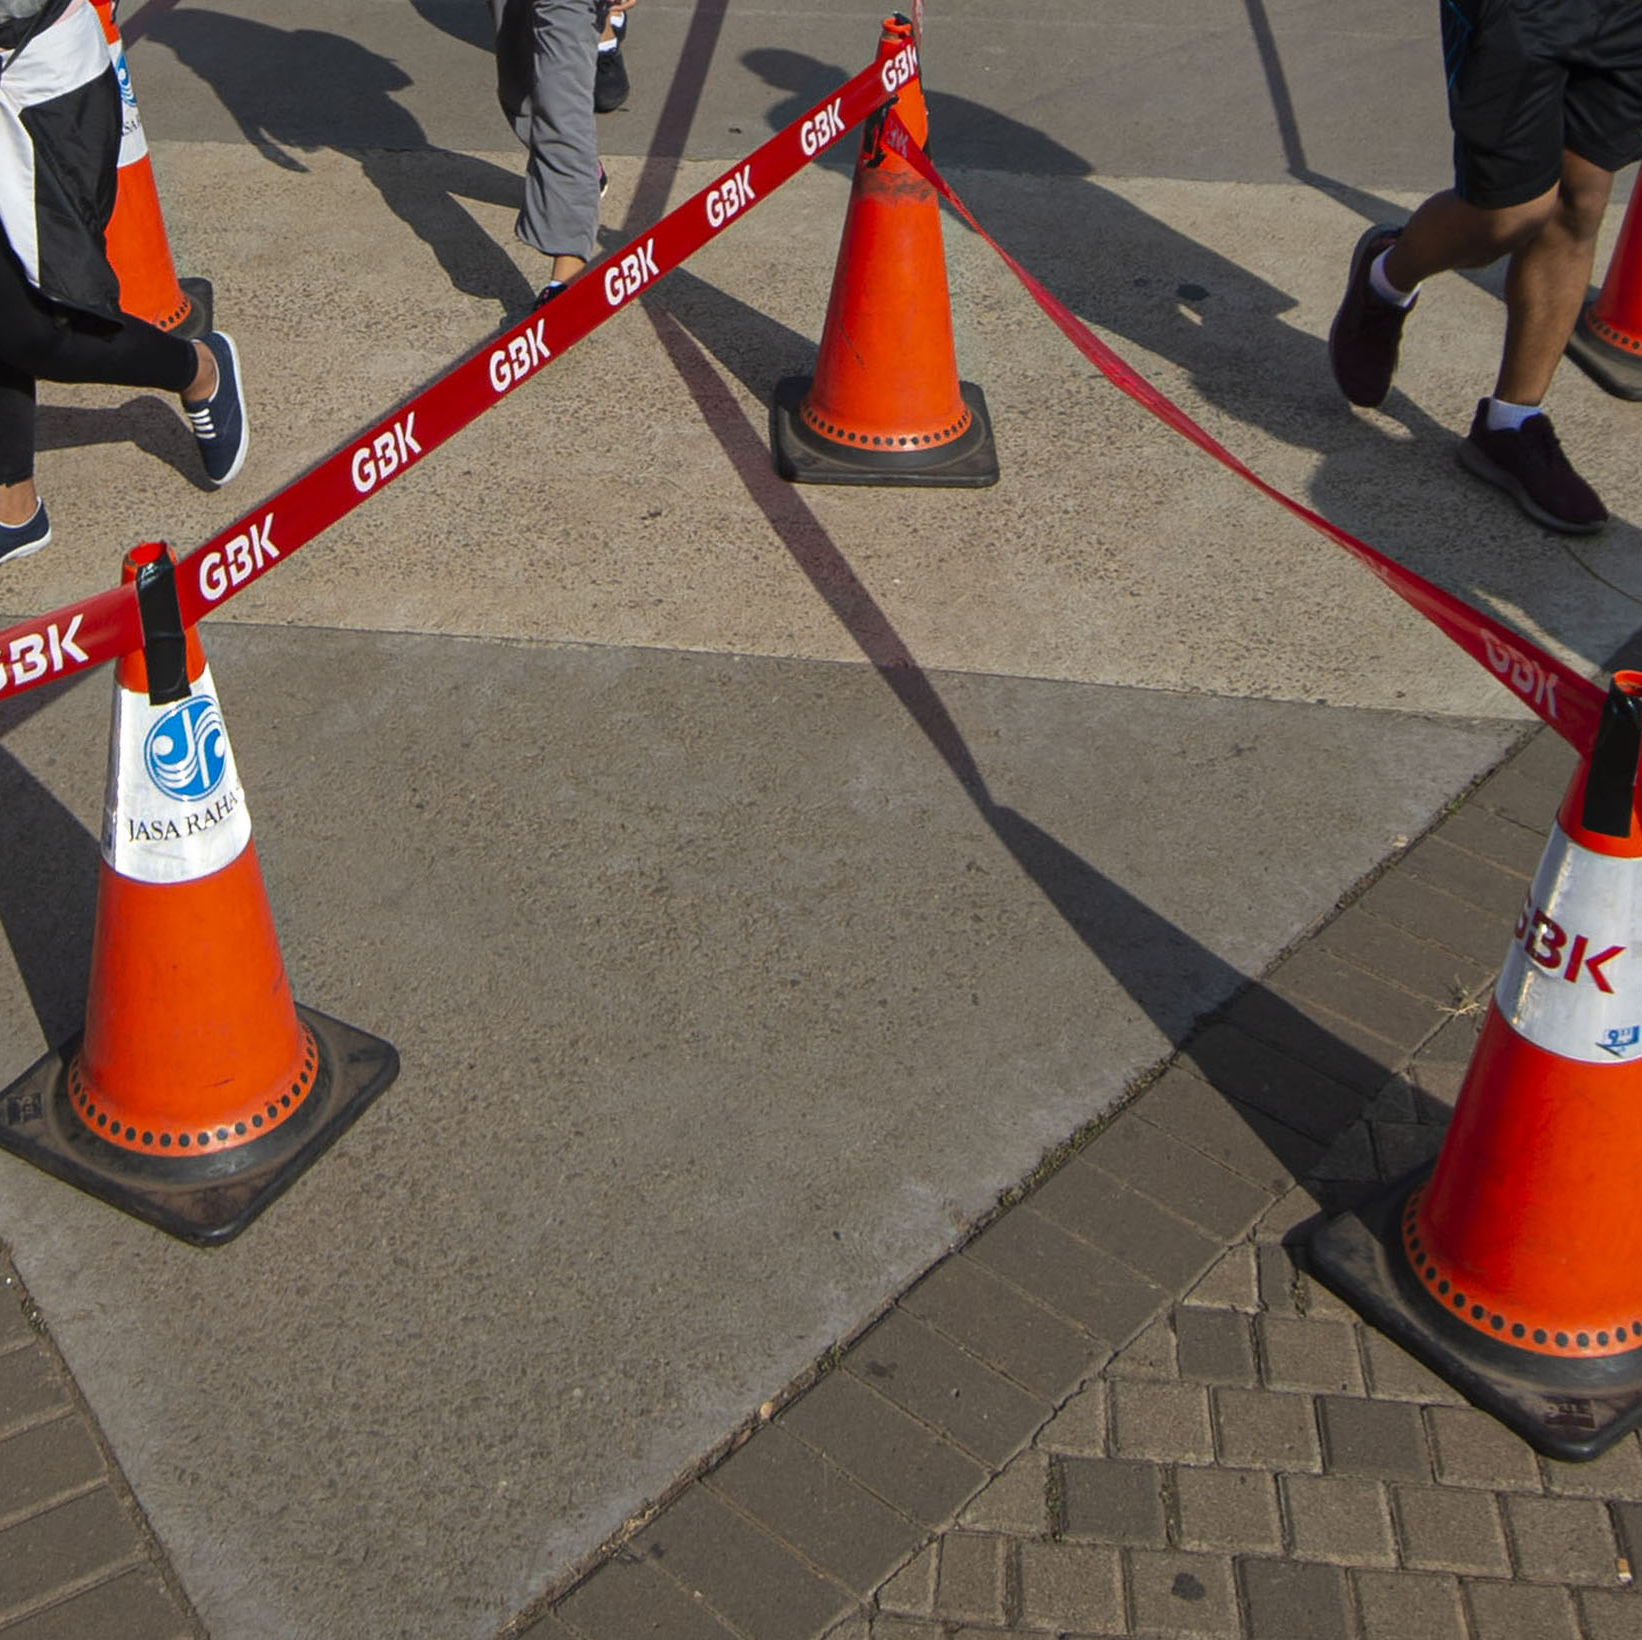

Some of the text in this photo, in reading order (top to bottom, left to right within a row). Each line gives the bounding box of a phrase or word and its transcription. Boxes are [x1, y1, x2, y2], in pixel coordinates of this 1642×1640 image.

[198, 513, 280, 602] GBK
[351, 411, 422, 493] GBK
[489, 319, 550, 393] GBK
[604, 239, 659, 306] GBK
[705, 165, 755, 228] GBK
[800, 98, 845, 156] GBK
[1479, 628, 1558, 718] GBK
[128, 819, 181, 843] JASA
